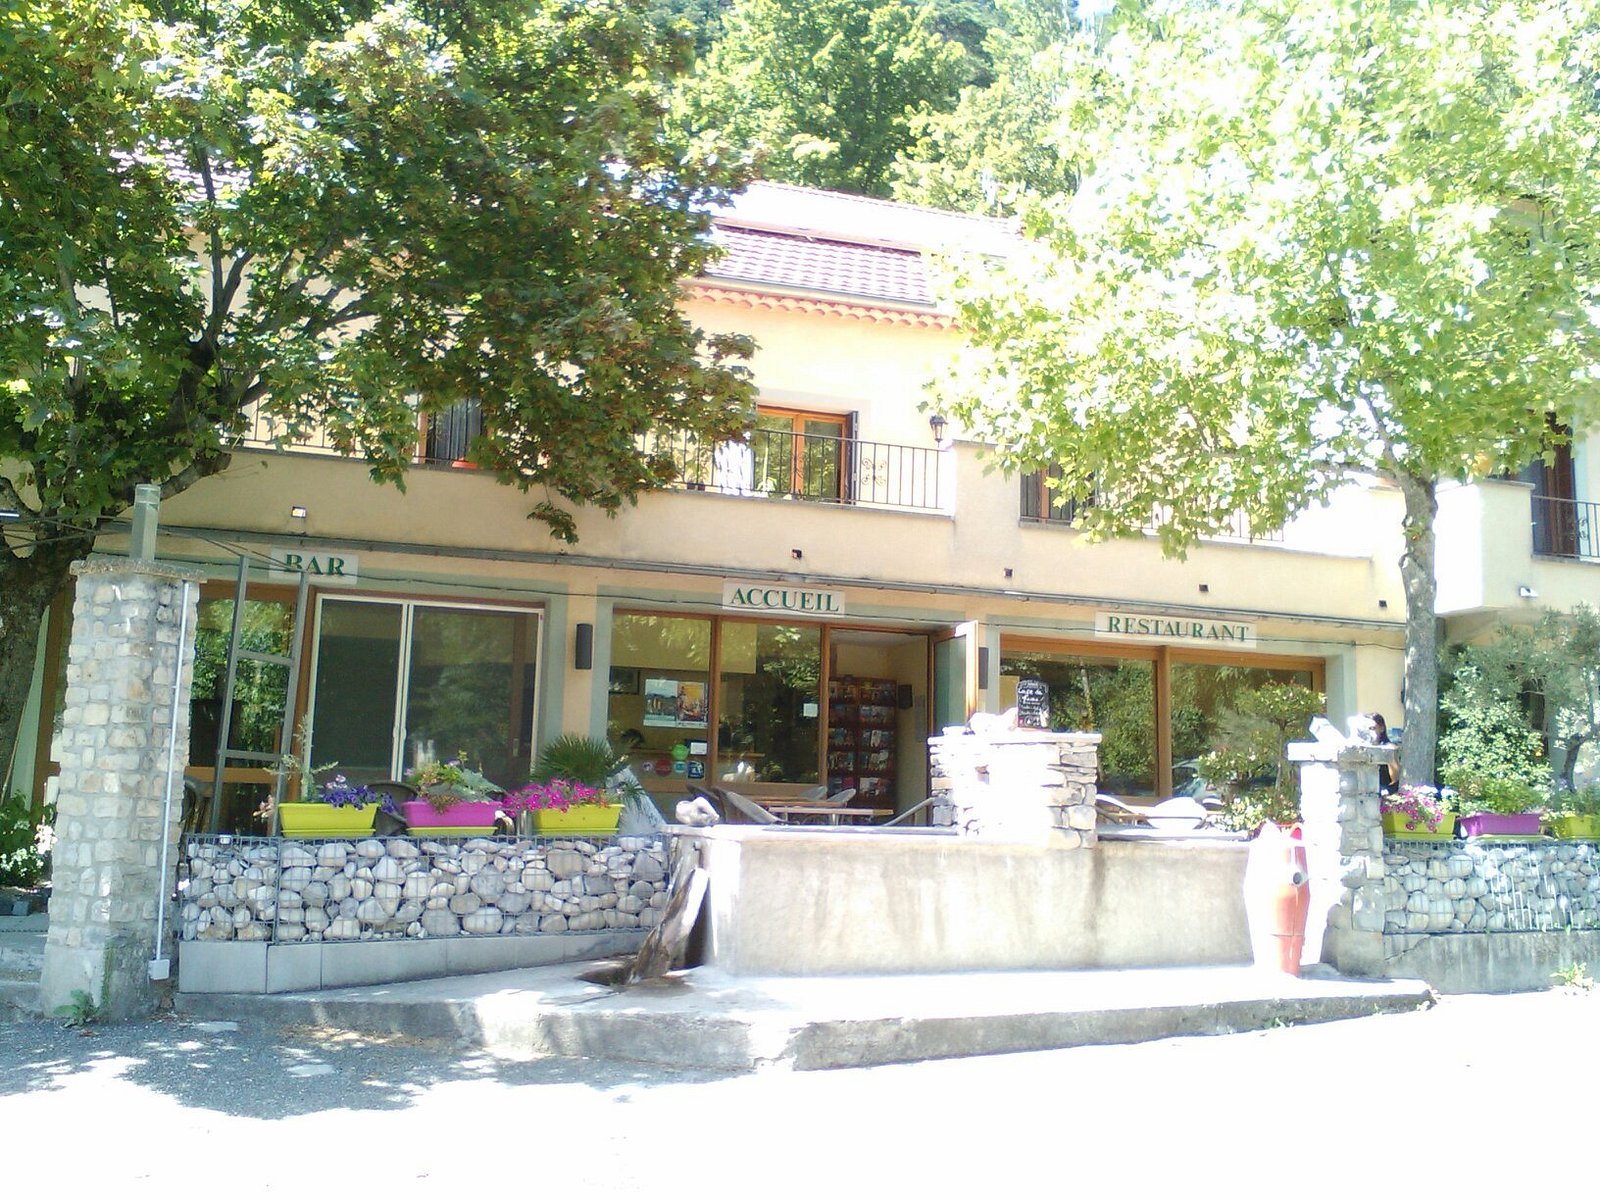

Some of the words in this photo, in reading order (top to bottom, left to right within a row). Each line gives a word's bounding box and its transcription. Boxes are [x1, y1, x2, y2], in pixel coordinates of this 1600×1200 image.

[286, 554, 345, 576] BAR
[730, 587, 840, 612] ACCUEIL
[1108, 616, 1249, 642] RESTAURANT
